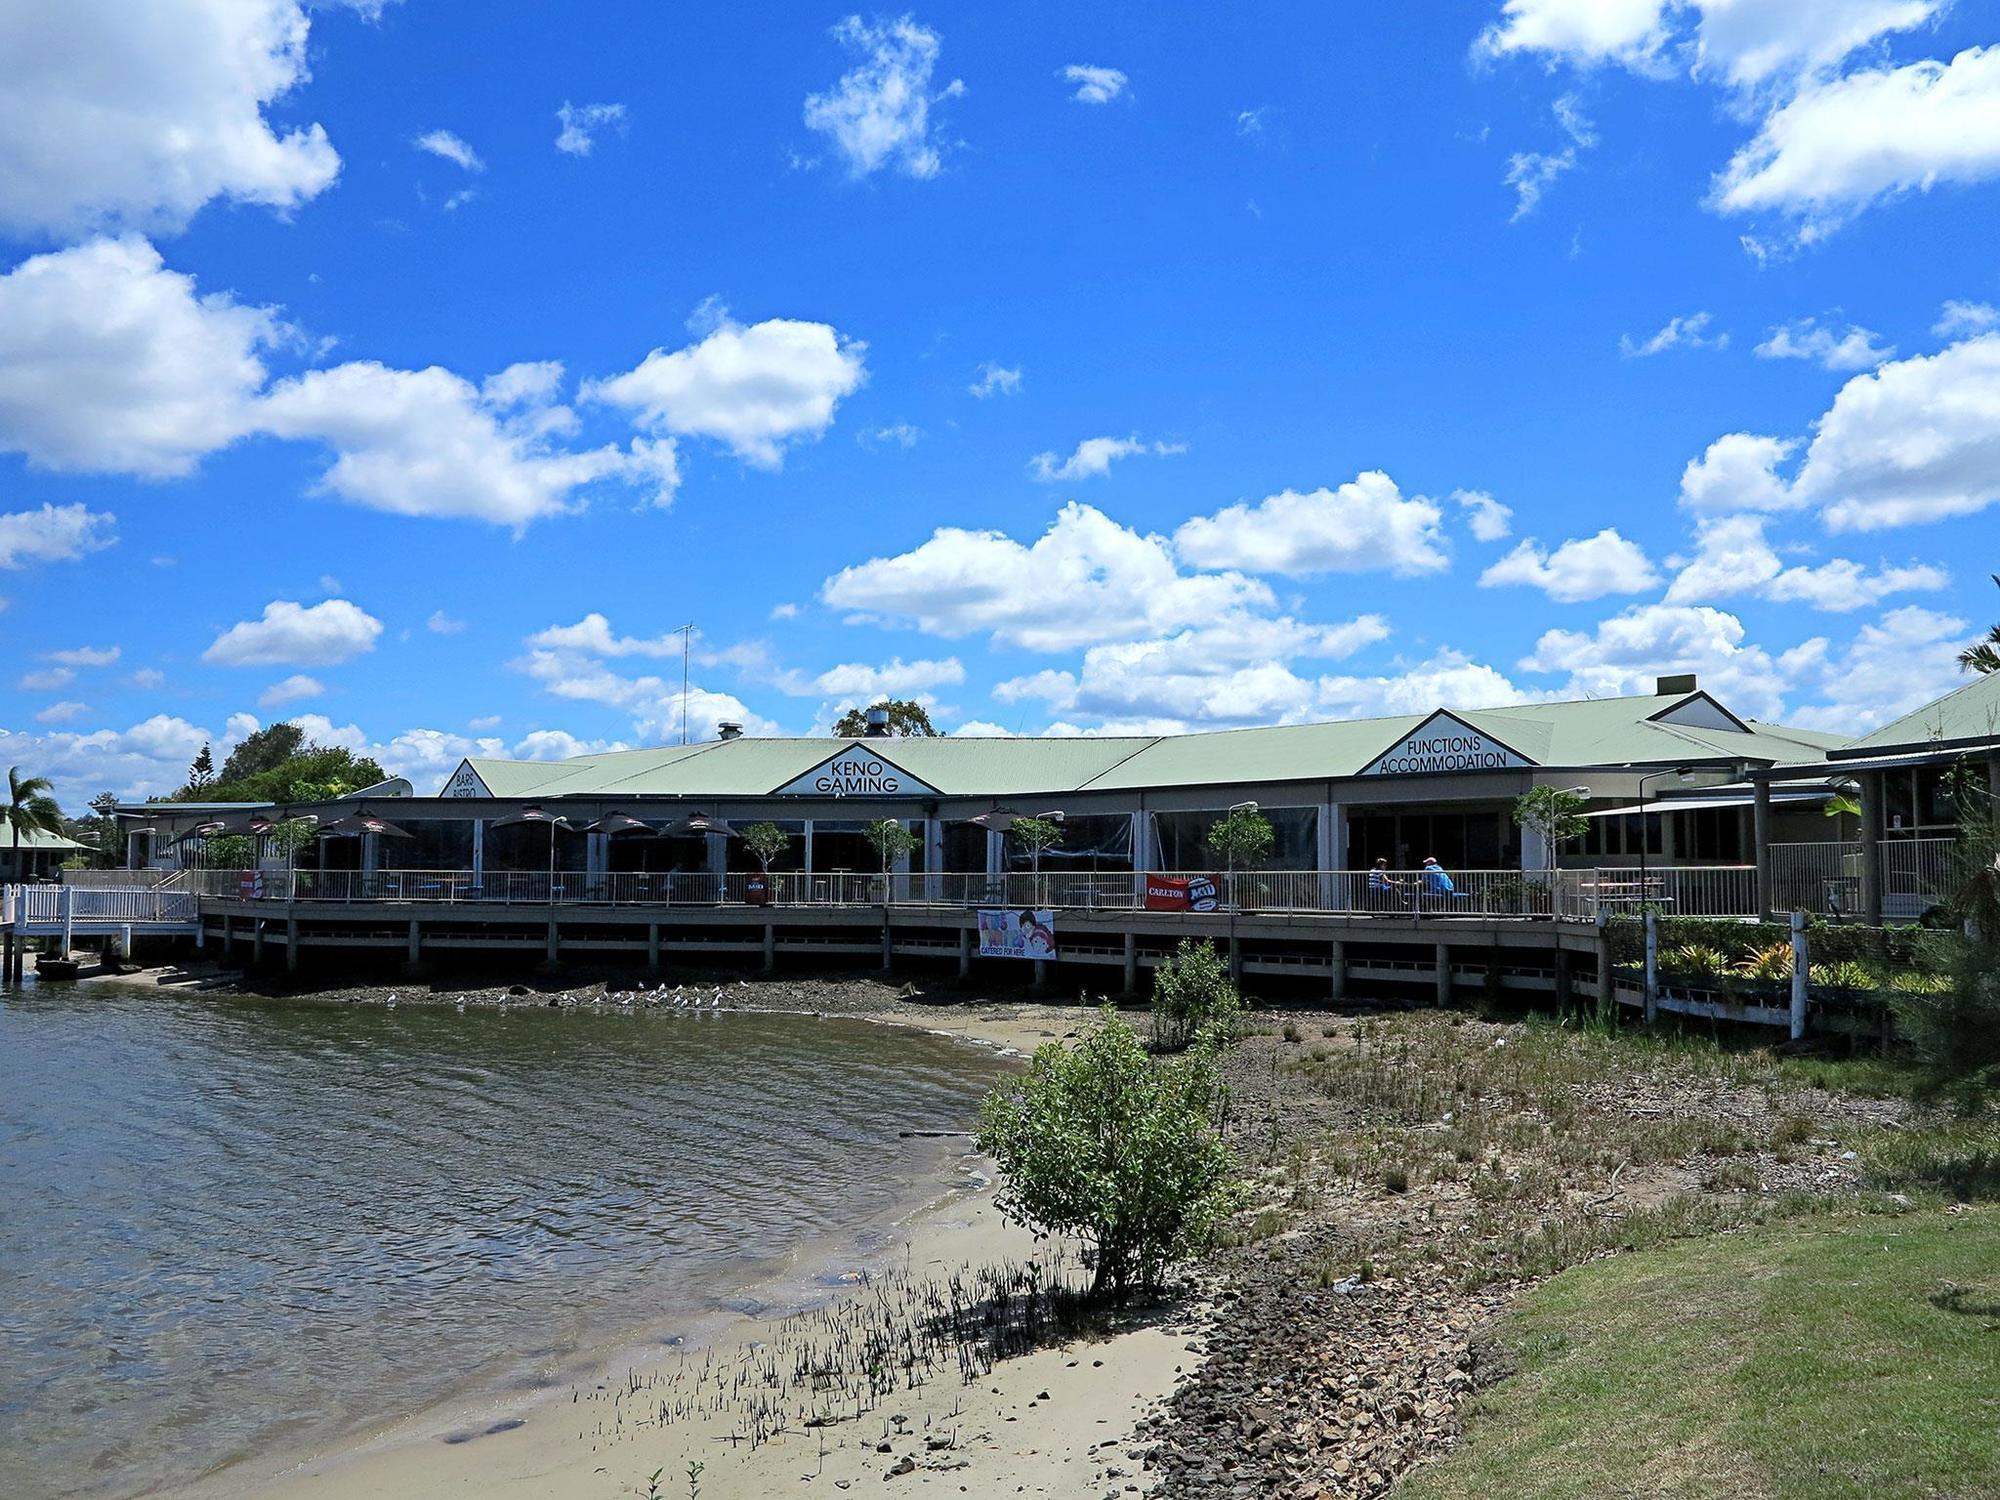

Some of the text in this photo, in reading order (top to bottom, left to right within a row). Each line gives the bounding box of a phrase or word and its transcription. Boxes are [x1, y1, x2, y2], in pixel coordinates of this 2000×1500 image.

[1407, 736, 1481, 755] FUNCTIONS
[831, 761, 883, 776] KENO
[1379, 752, 1507, 774] ACCOMMODATION
[456, 773, 474, 787] BARS
[815, 777, 899, 792] GAMING
[1148, 887, 1184, 898] CARLTON
[1003, 947, 1013, 955] FOR
[1013, 948, 1025, 956] HERE
